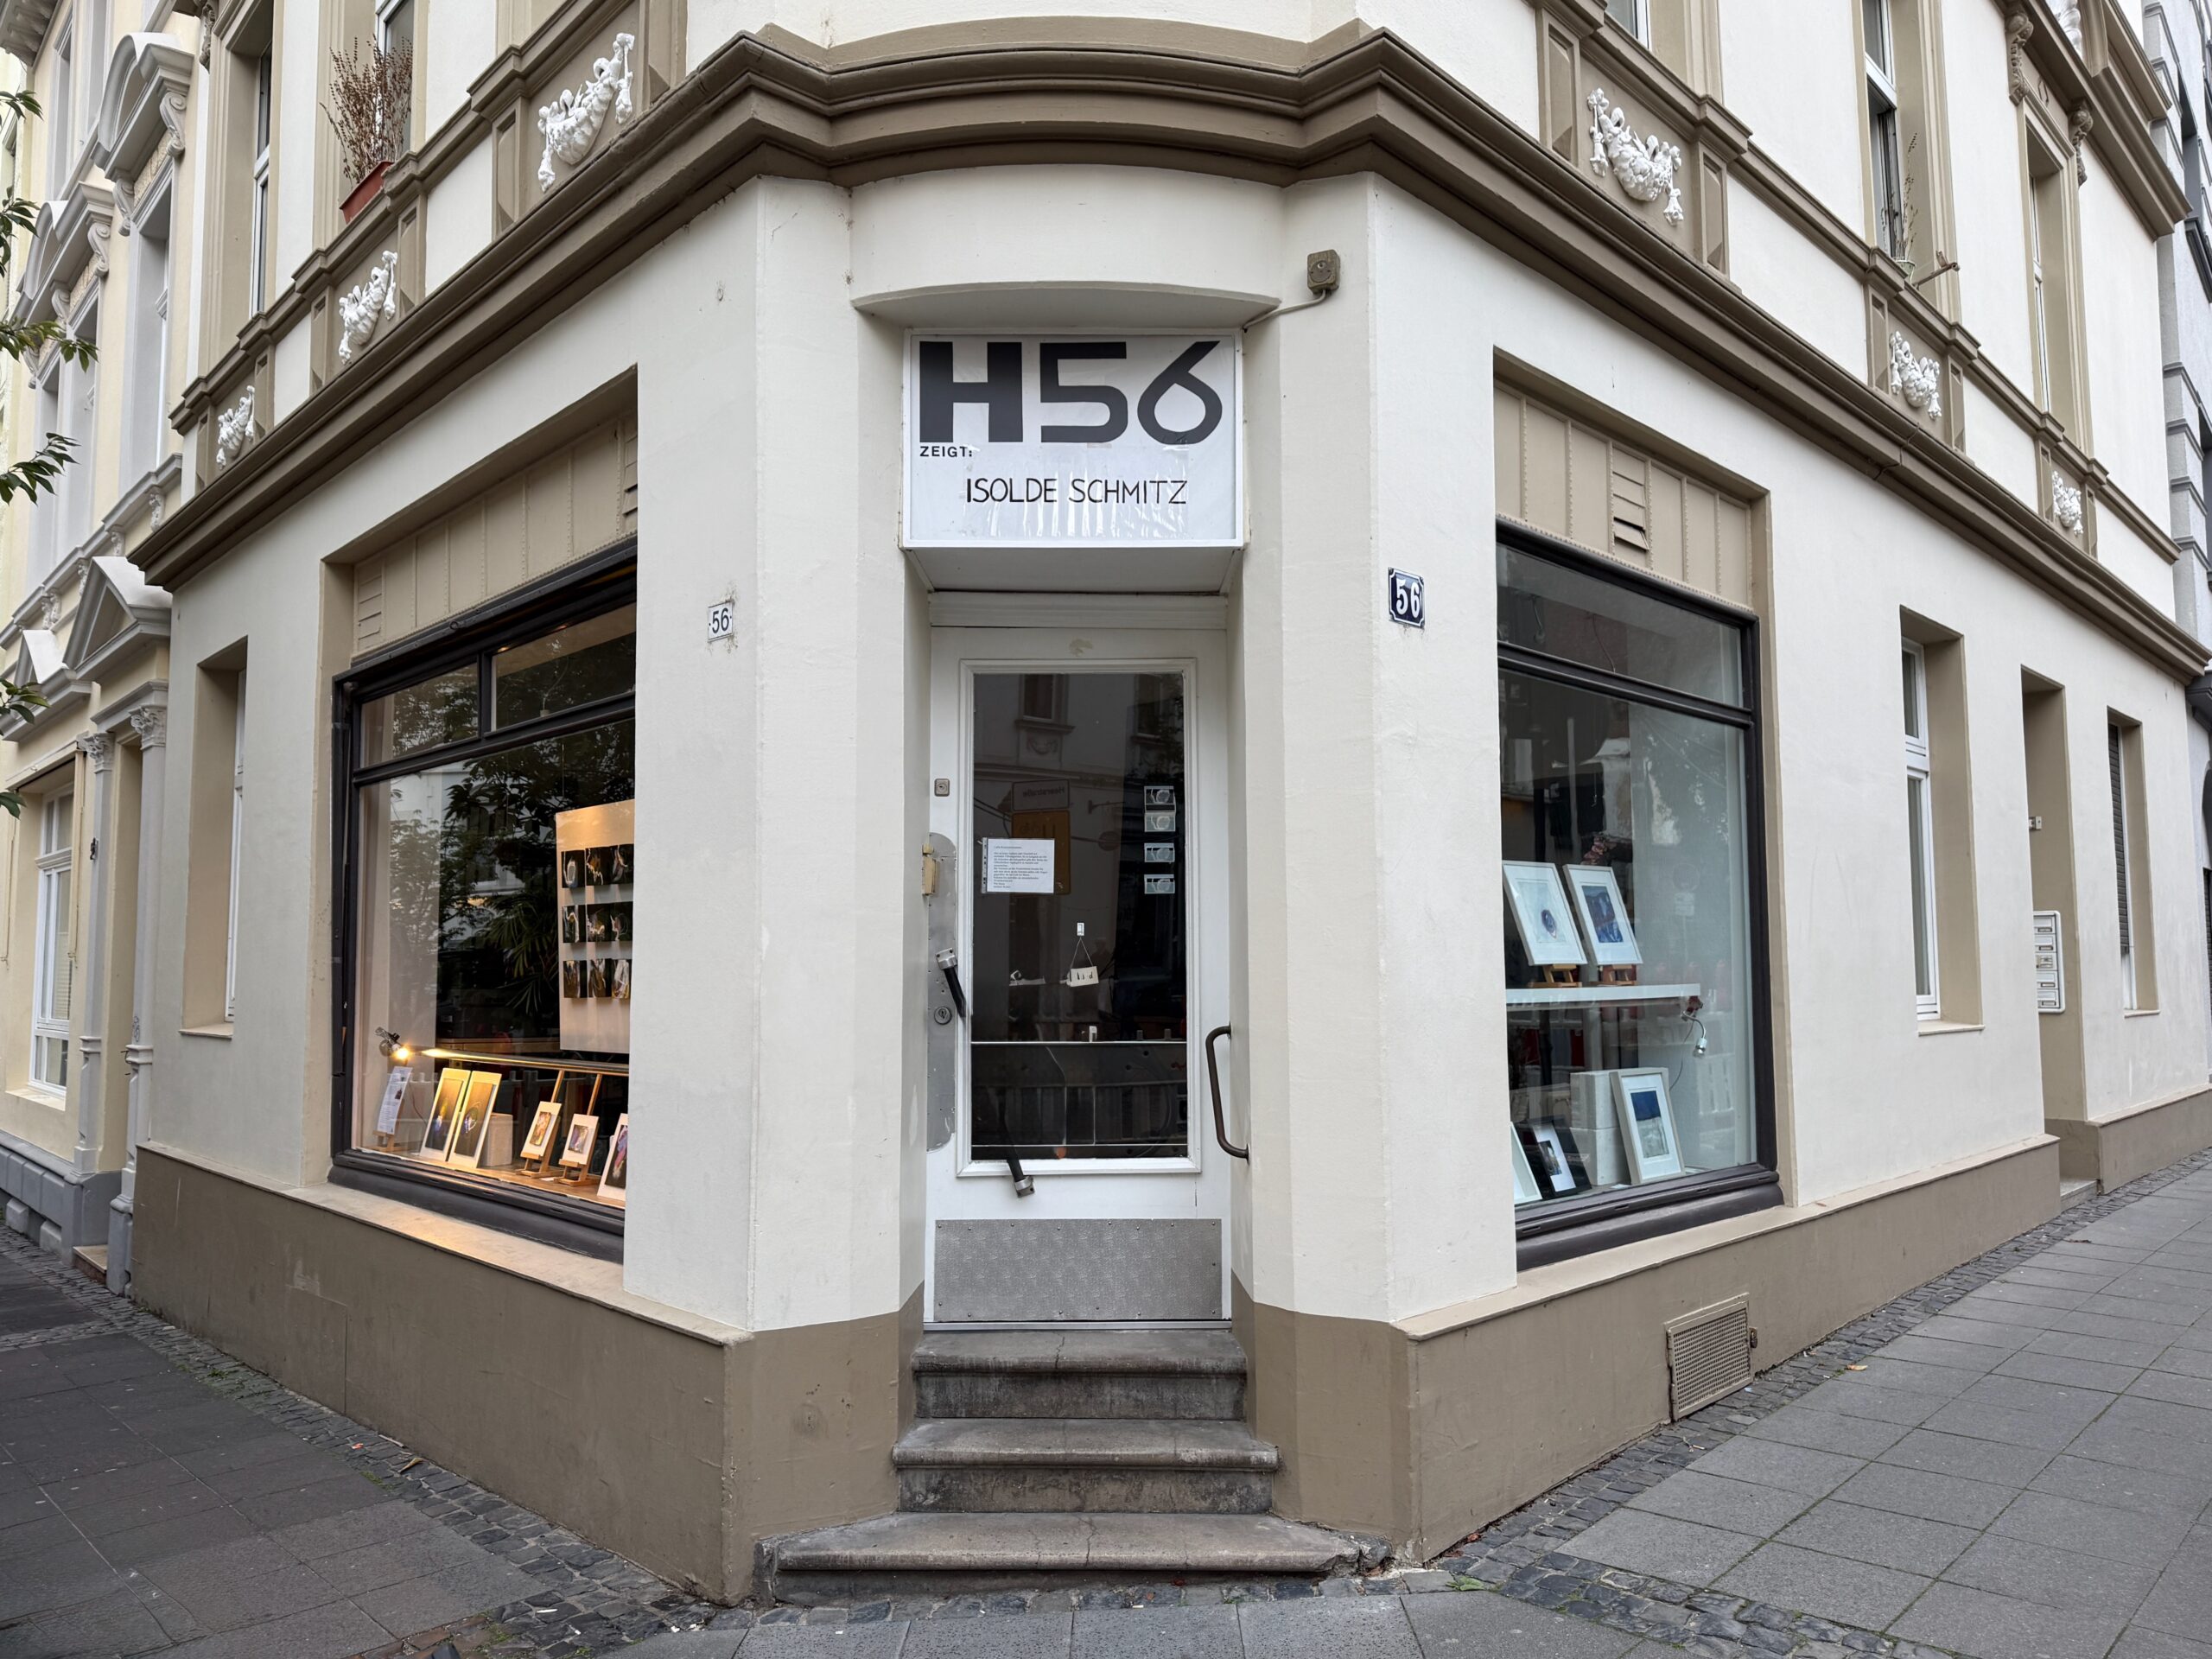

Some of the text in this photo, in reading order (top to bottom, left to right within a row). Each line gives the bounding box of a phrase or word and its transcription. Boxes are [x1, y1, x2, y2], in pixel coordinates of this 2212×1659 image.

[919, 340, 1223, 444] H56
[919, 446, 973, 458] ZEIGT:
[966, 478, 1188, 505] ISOLDE SCHMITZ
[1395, 577, 1421, 618] 56
[712, 607, 729, 633] 56
